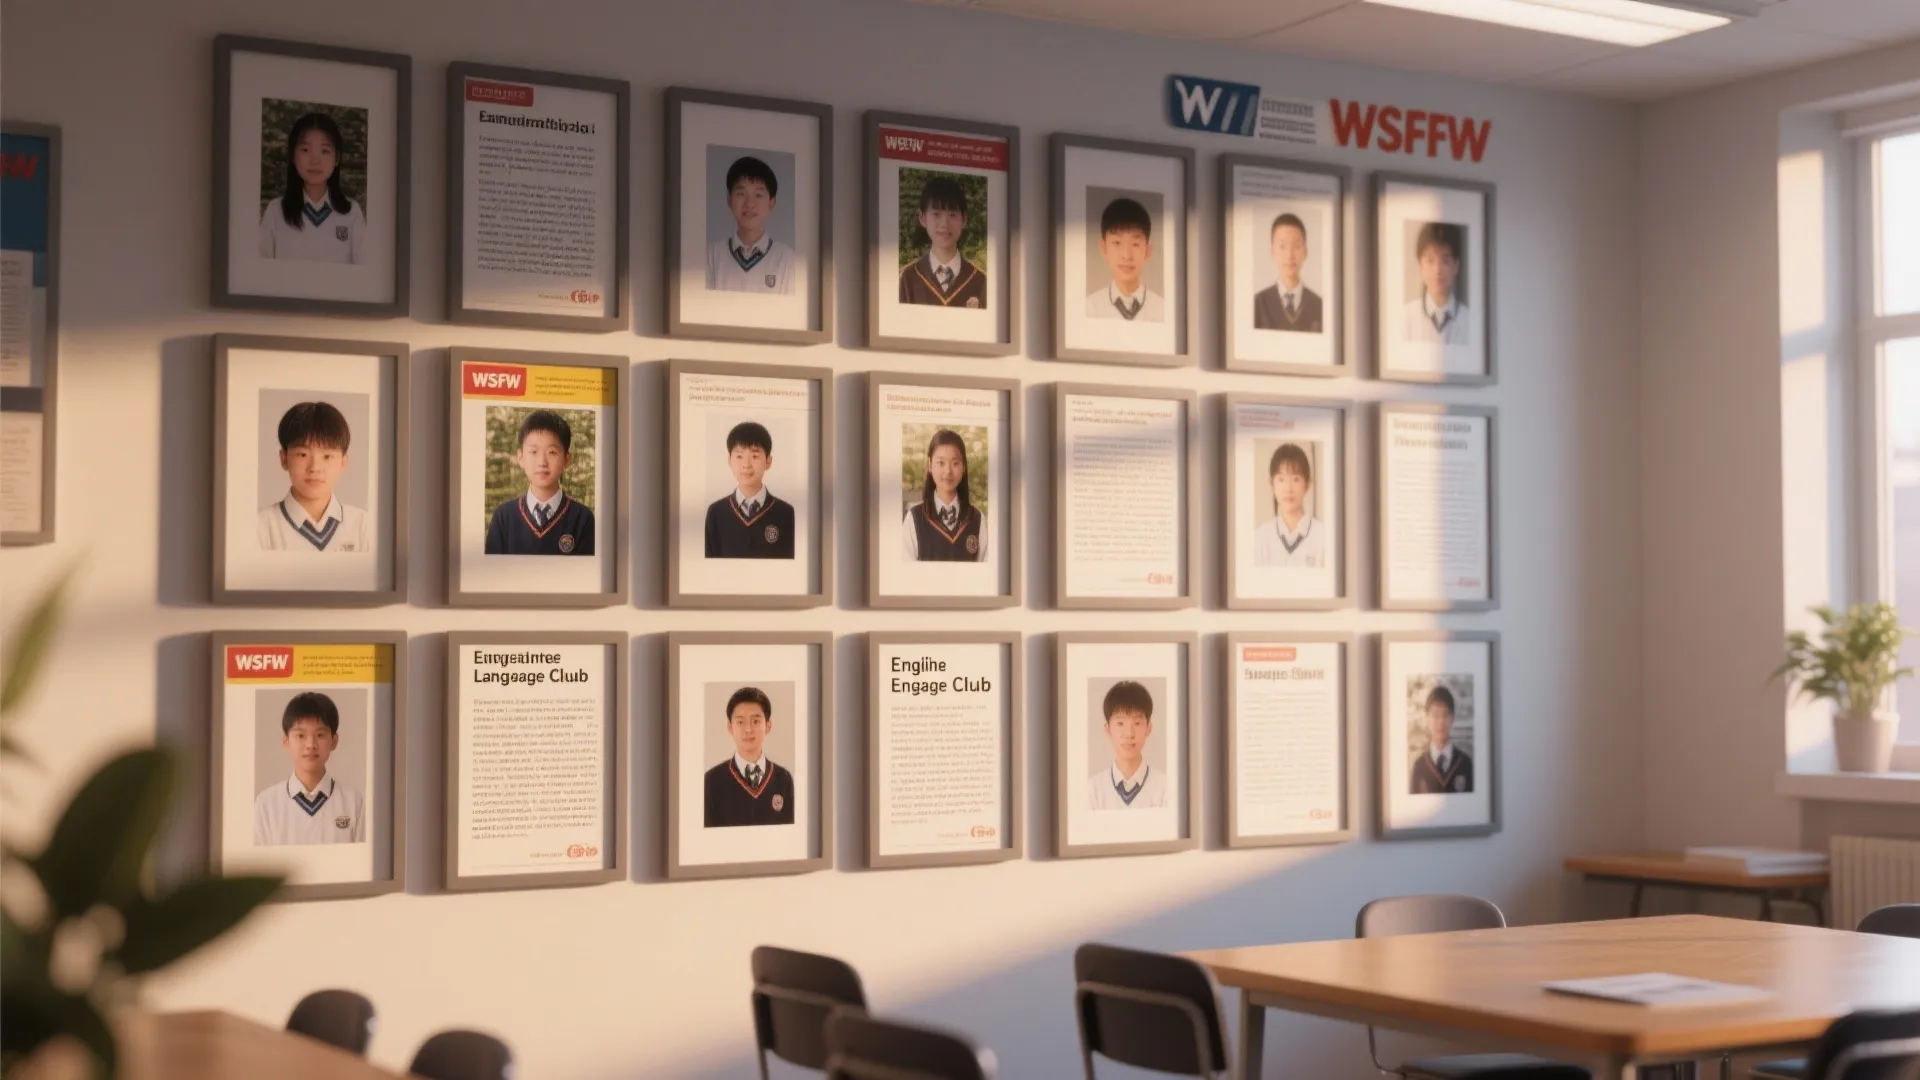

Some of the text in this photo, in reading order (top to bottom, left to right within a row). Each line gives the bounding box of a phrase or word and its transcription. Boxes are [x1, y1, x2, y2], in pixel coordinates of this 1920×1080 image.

[1329, 98, 1492, 163] WSFFW
[472, 372, 522, 389] WSFW
[235, 654, 289, 671] WSFW
[891, 676, 991, 696] Engage Club
